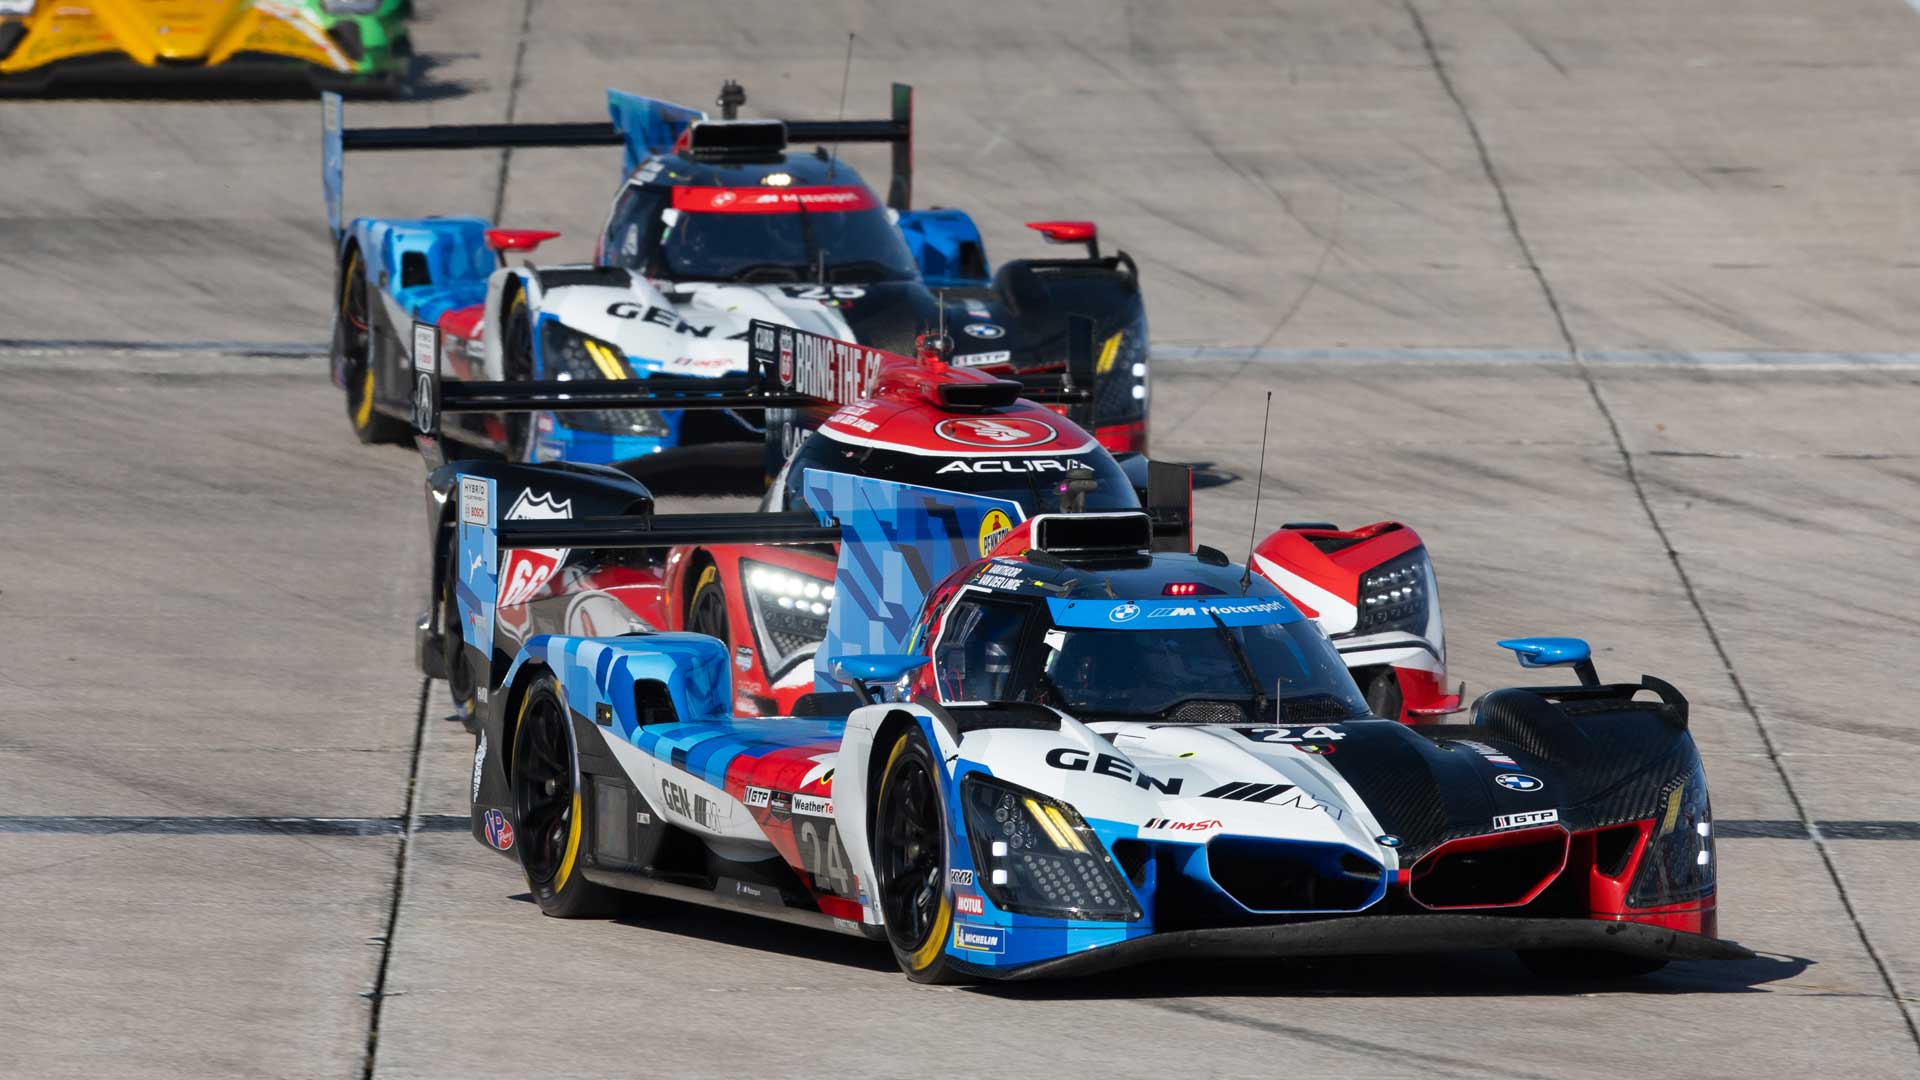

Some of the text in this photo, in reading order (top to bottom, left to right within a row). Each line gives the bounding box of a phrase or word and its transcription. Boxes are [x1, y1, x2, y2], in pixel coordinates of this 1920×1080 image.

[796, 286, 866, 299] 25
[606, 302, 716, 339] GEN
[796, 332, 835, 402] BRING
[836, 343, 862, 406] THE
[936, 459, 1096, 474] ACURA
[502, 559, 551, 610] 66
[1200, 601, 1286, 616] Motorsport
[1252, 726, 1347, 742] 24
[1045, 747, 1184, 795] GEN
[662, 777, 693, 820] GEN
[751, 790, 769, 804] GTP
[1169, 819, 1223, 831] IMSA
[1515, 811, 1553, 823] GTP
[801, 820, 850, 894] 24
[957, 895, 983, 913] MOTUL
[964, 932, 998, 946] MICHELIN
